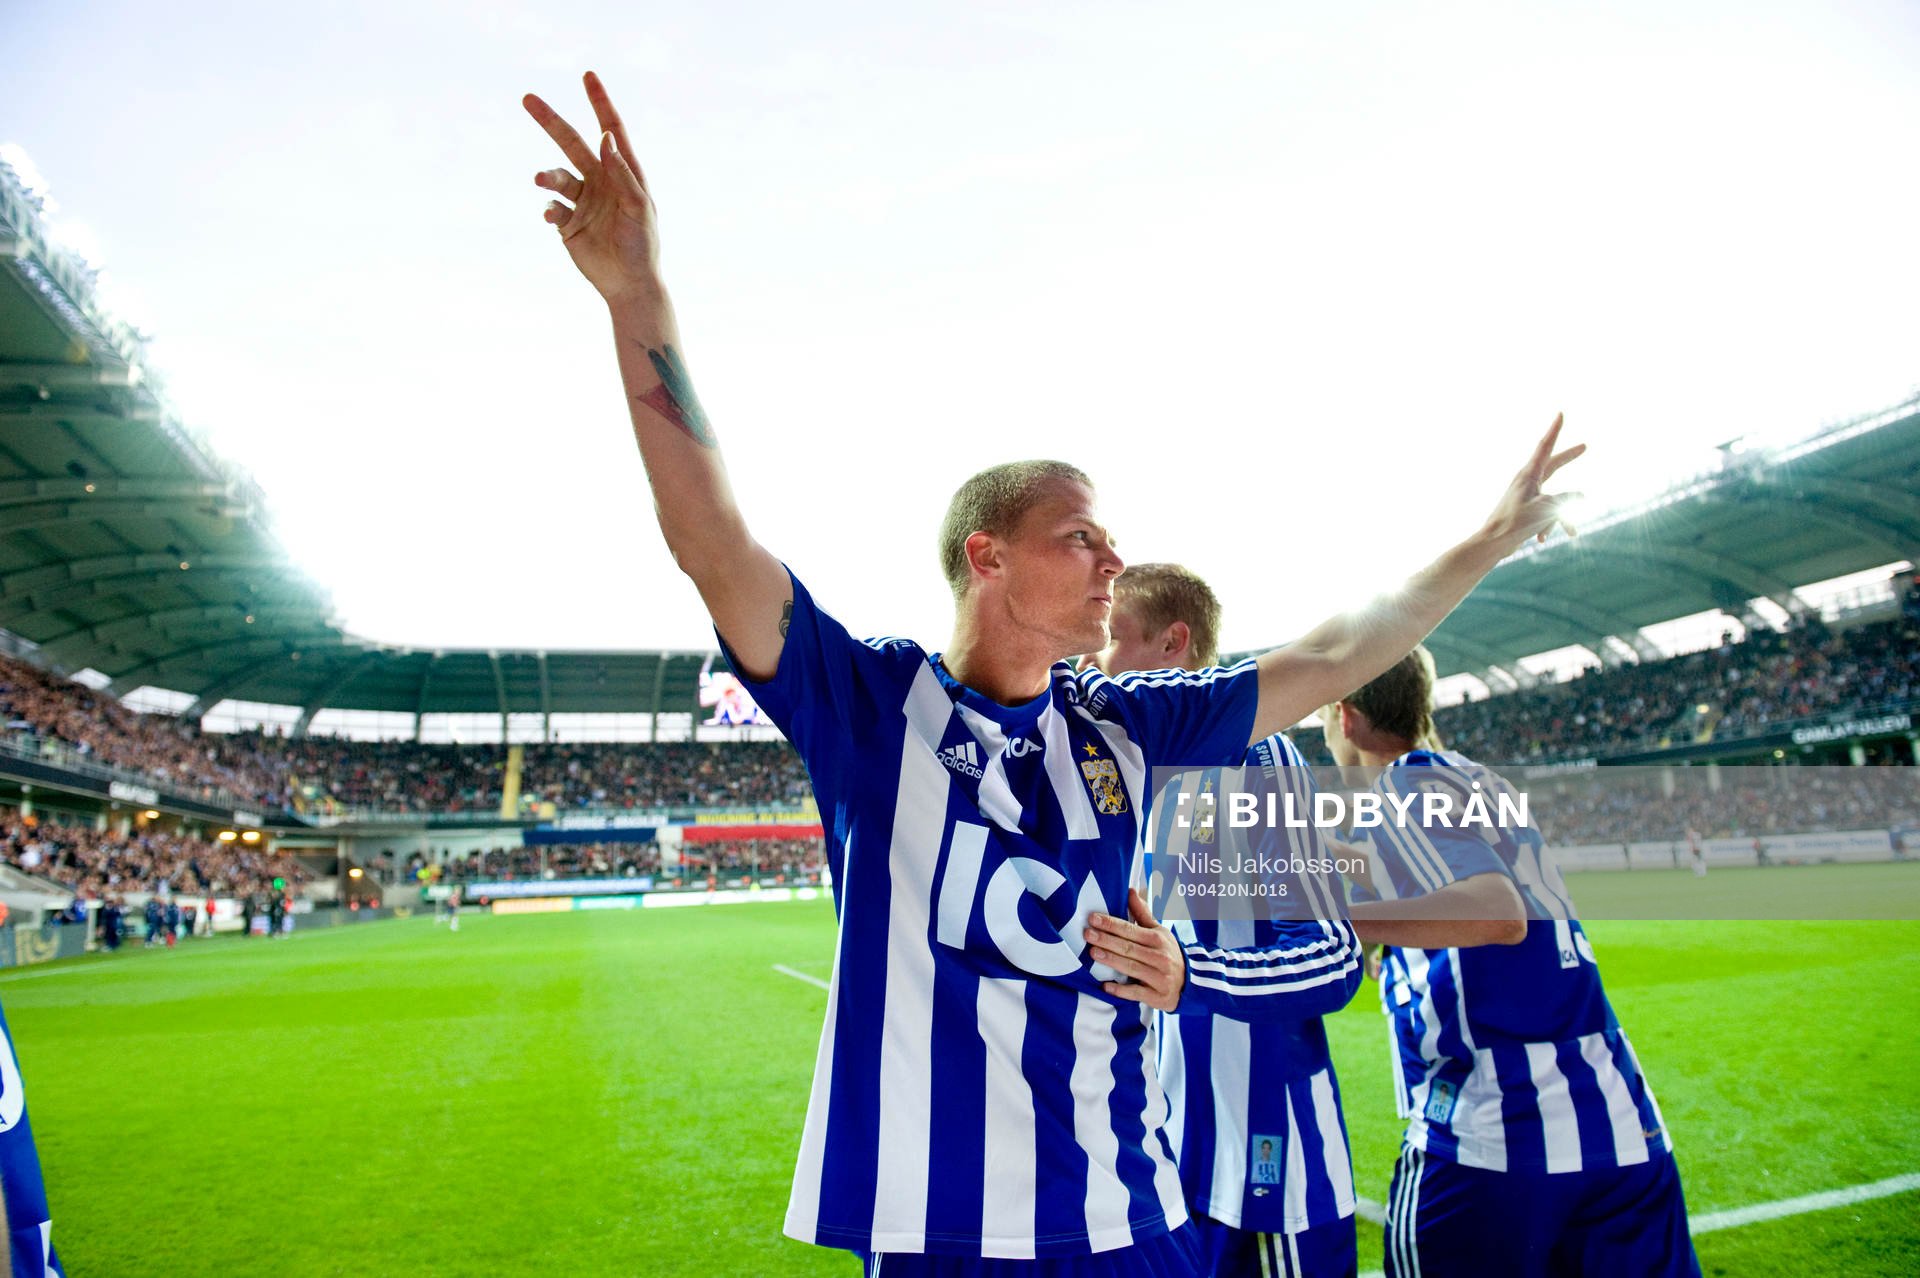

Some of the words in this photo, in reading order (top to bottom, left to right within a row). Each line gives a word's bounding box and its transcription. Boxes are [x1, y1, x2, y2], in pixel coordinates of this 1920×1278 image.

[1005, 737, 1043, 759] ICA
[1256, 744, 1276, 779] SPORTIA
[936, 751, 983, 779] adidas
